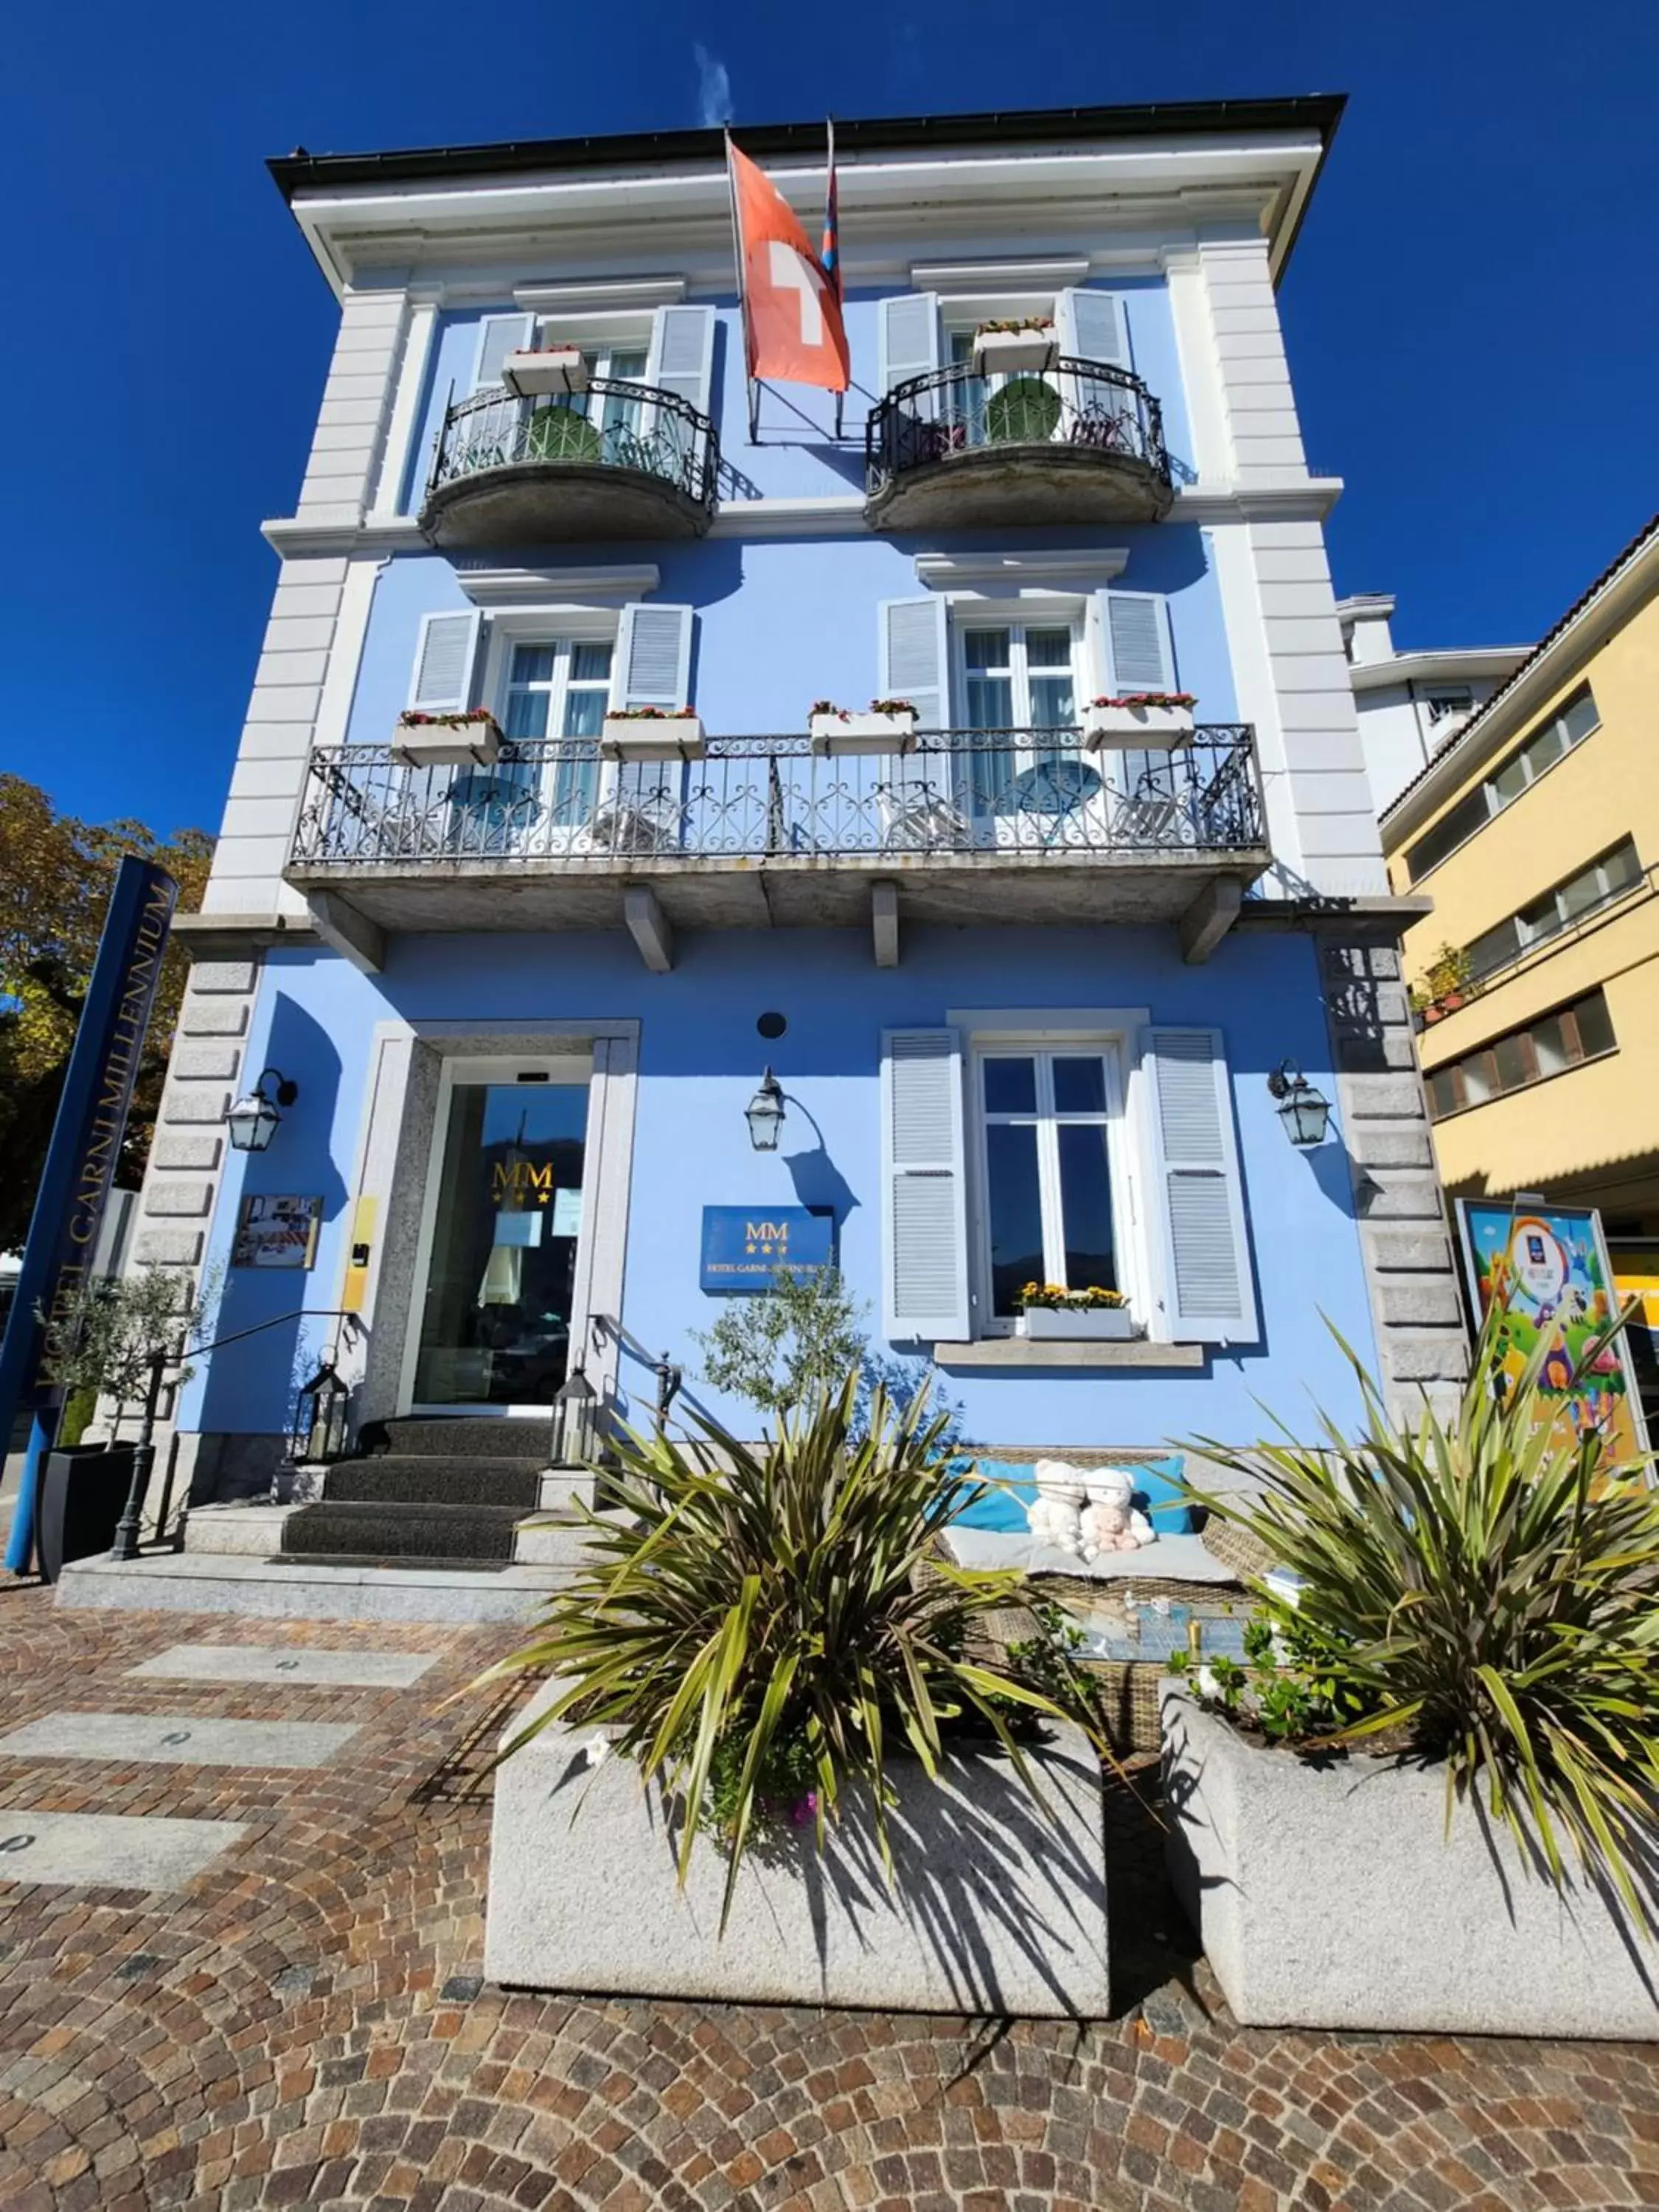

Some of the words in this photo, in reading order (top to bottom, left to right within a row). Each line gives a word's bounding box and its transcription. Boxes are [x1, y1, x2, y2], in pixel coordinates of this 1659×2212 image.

[69, 1117, 116, 1243] GARNI
[98, 883, 173, 1108] MILLENNIUM
[492, 1162, 553, 1188] MM
[745, 1221, 788, 1240] MM
